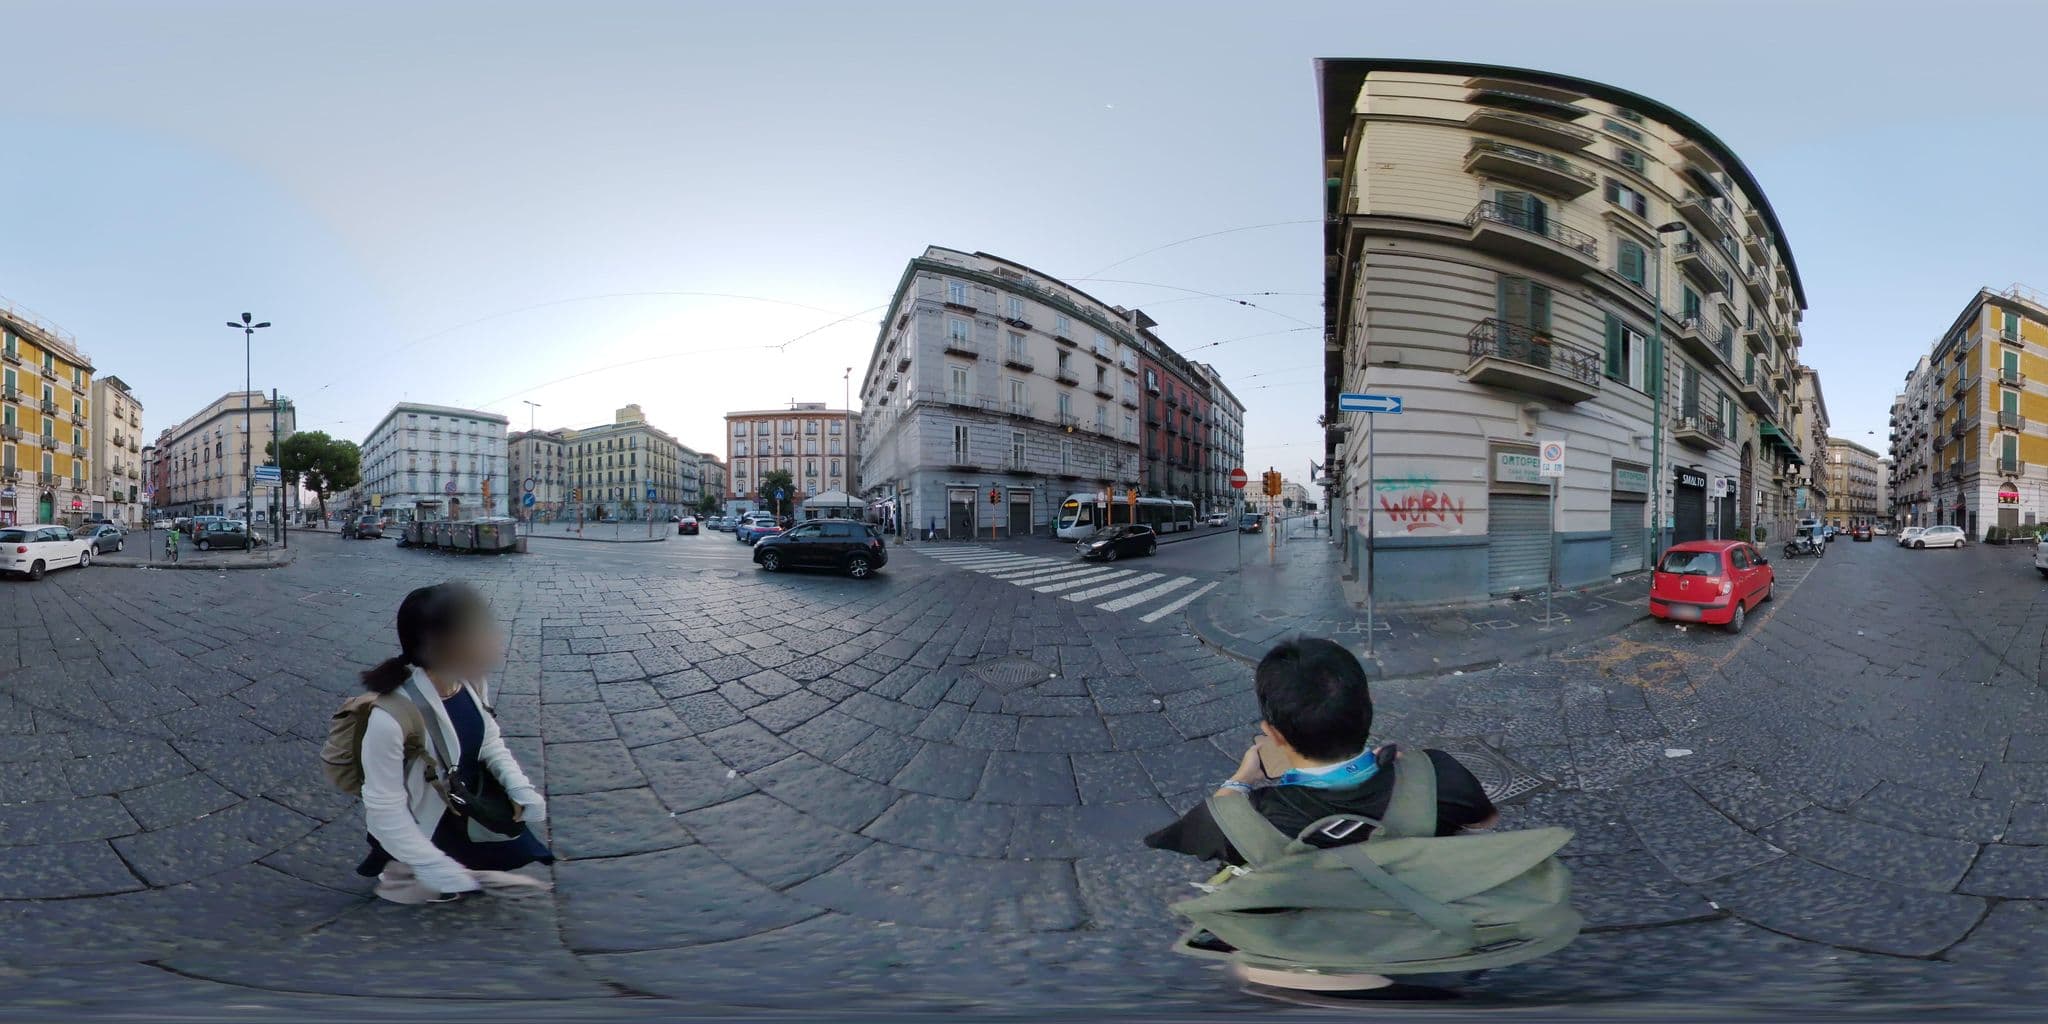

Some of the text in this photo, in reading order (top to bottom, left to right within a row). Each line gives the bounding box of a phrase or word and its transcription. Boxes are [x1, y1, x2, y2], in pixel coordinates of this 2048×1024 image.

[1502, 455, 1540, 468] ORTOPE
[1682, 474, 1705, 487] SMALTO
[1380, 490, 1464, 525] WORN
